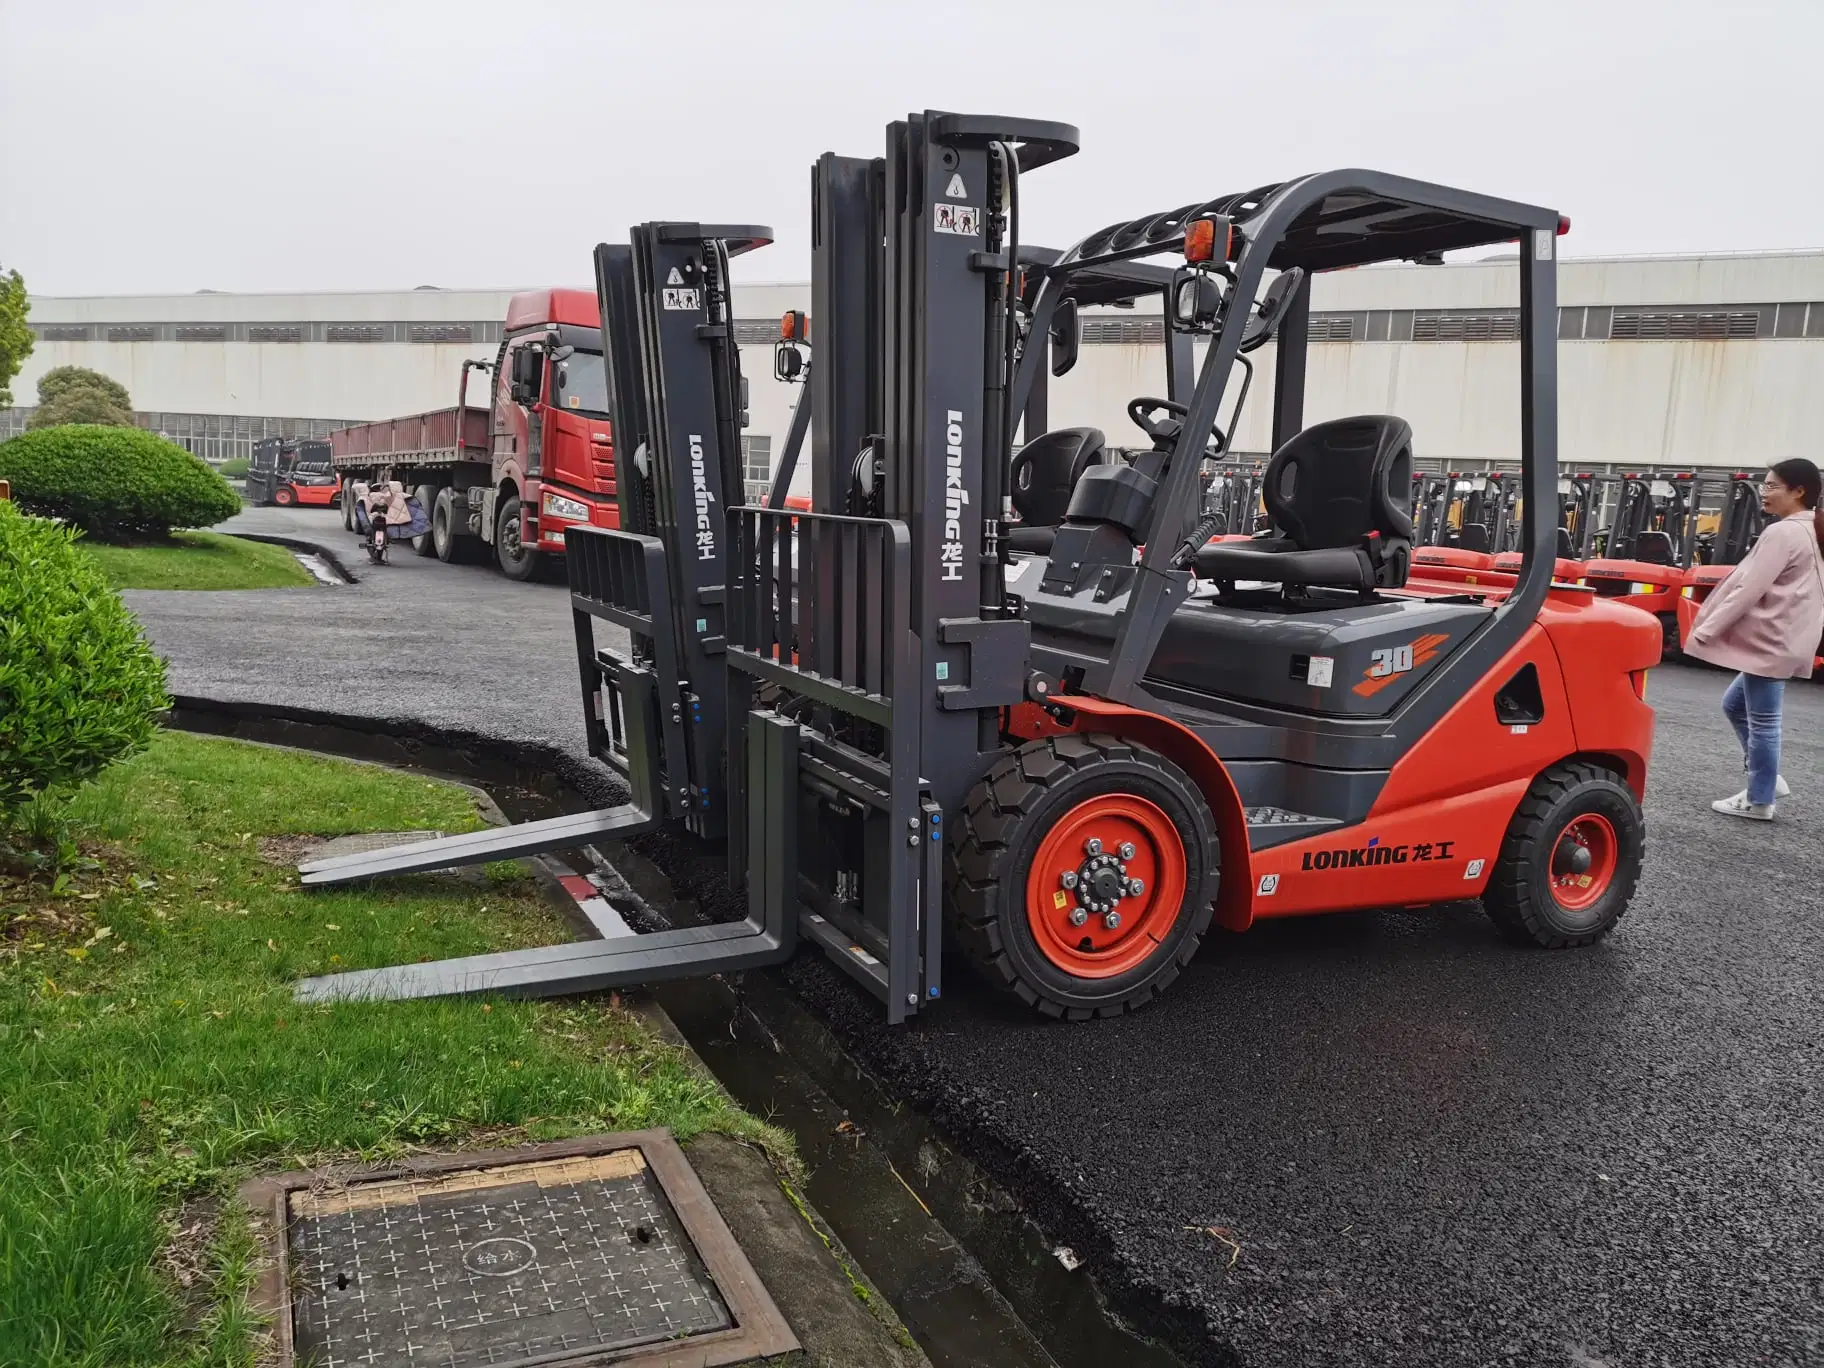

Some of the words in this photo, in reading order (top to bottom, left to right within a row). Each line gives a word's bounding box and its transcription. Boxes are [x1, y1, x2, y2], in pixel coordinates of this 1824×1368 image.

[695, 530, 716, 560] 龙工
[941, 541, 963, 581] 龙工
[1371, 645, 1413, 678] 30
[1412, 841, 1455, 862] 龙工
